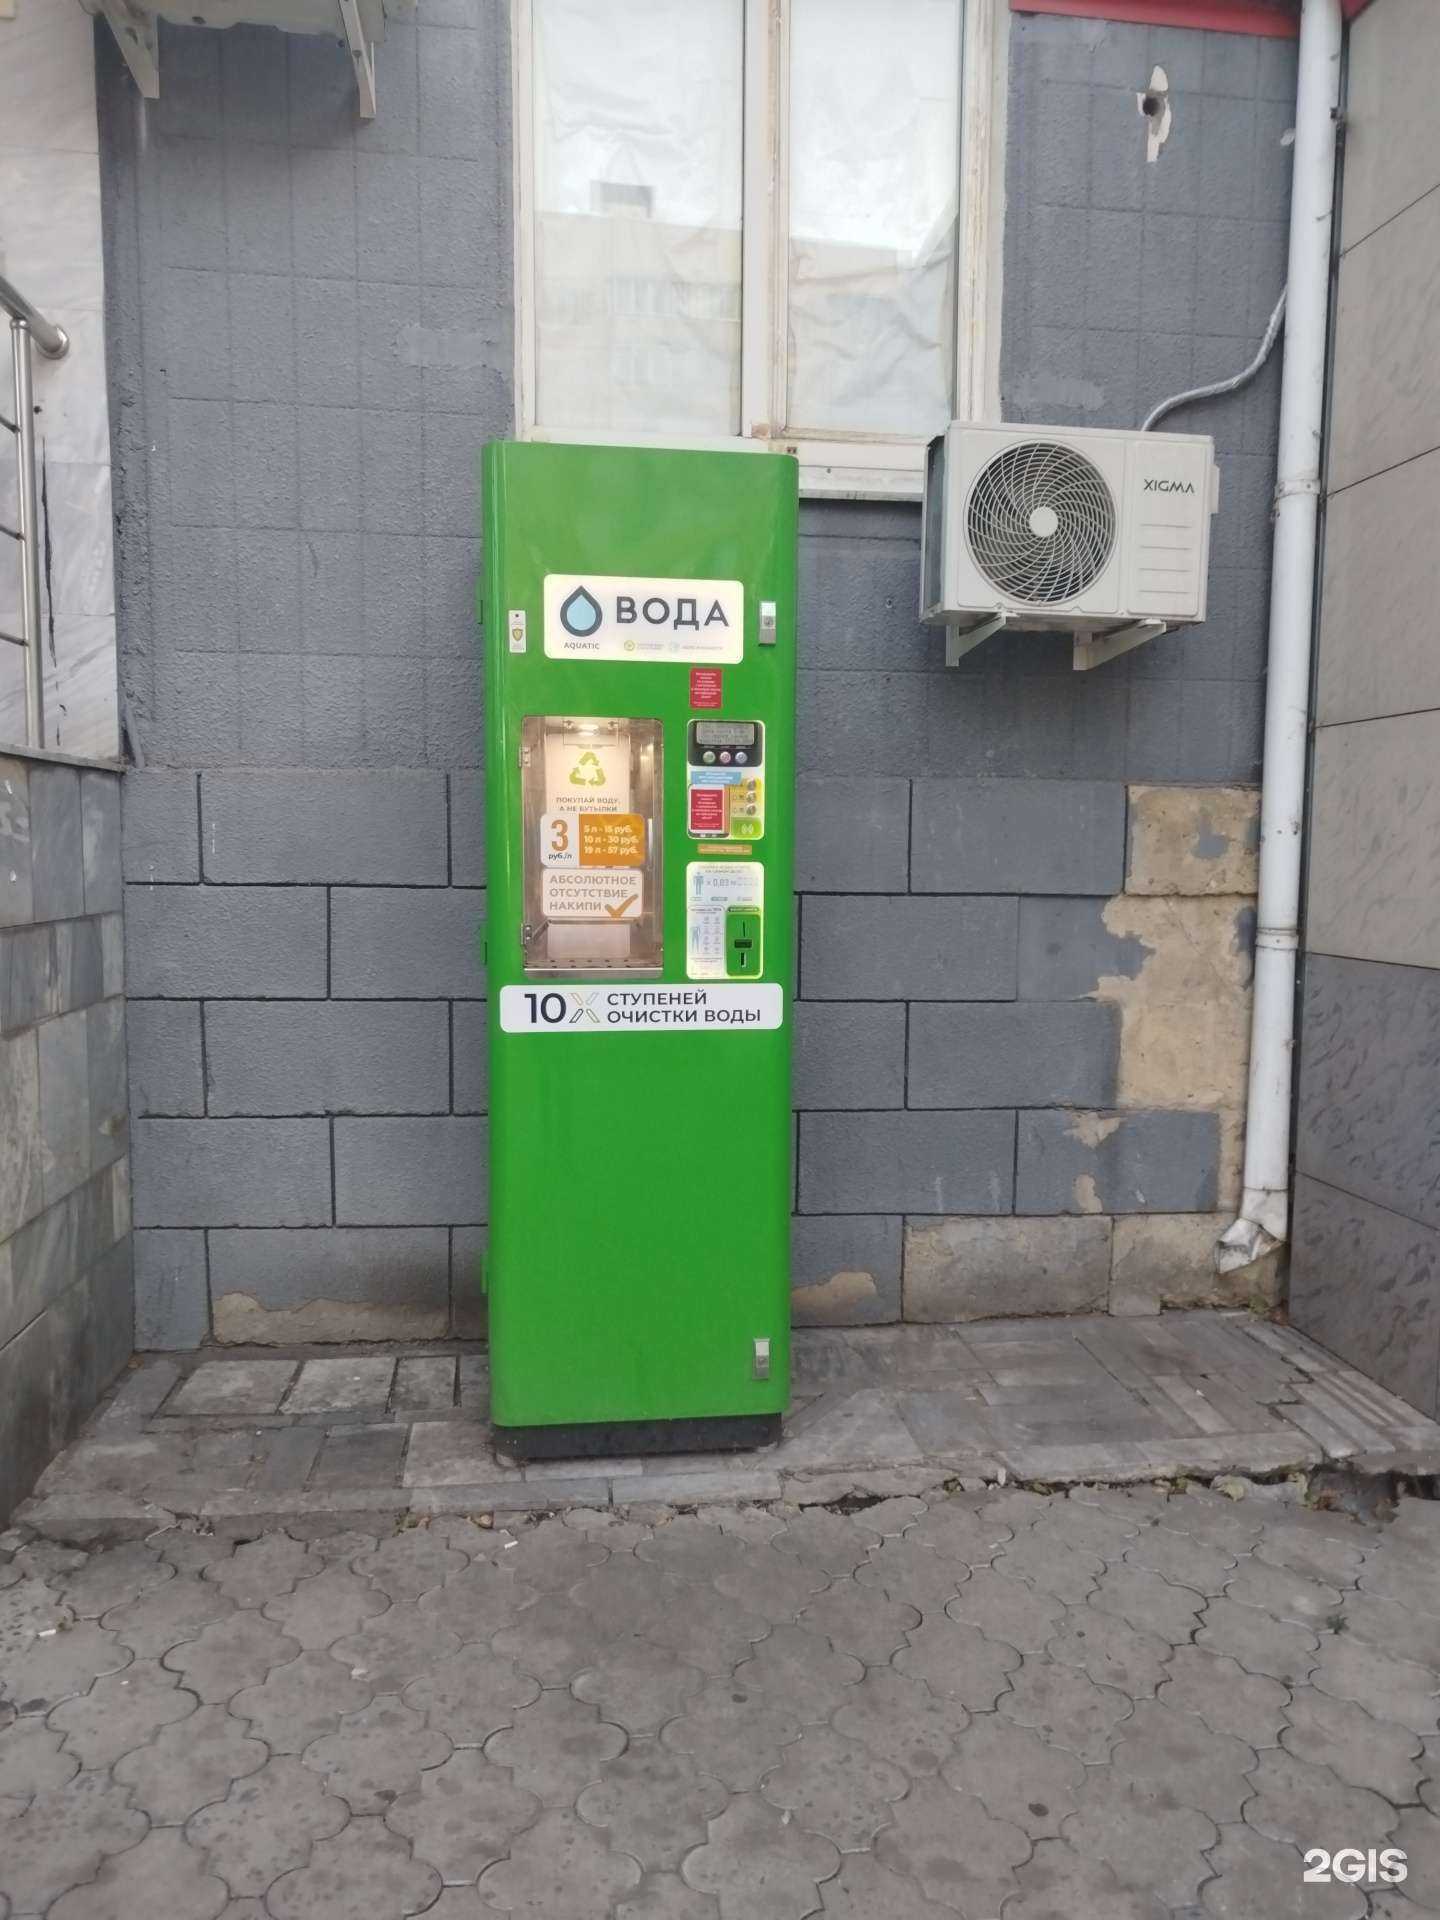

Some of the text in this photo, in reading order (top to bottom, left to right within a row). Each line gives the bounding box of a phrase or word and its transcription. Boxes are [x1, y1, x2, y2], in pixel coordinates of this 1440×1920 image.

[1144, 479, 1195, 493] XIGMA
[616, 596, 729, 631] ВОДА
[563, 642, 600, 651] AQUATIC
[556, 796, 594, 804] ПОКУПАЙ
[615, 825, 632, 834] руб.
[551, 819, 569, 851] 3
[584, 835, 594, 843] 10
[607, 835, 619, 843] 30
[620, 835, 639, 845] руб.
[584, 846, 594, 854] 19
[620, 847, 638, 855] руб.
[549, 875, 637, 885] АБСОЛЮТНОЕ
[549, 888, 628, 898] ОТСУТСТВИЕ
[549, 901, 602, 911] НАКИПИ
[607, 989, 707, 1006] СТУПЕНЕЙ
[607, 1009, 760, 1024] ОЧИСТКИ ВОДЫ
